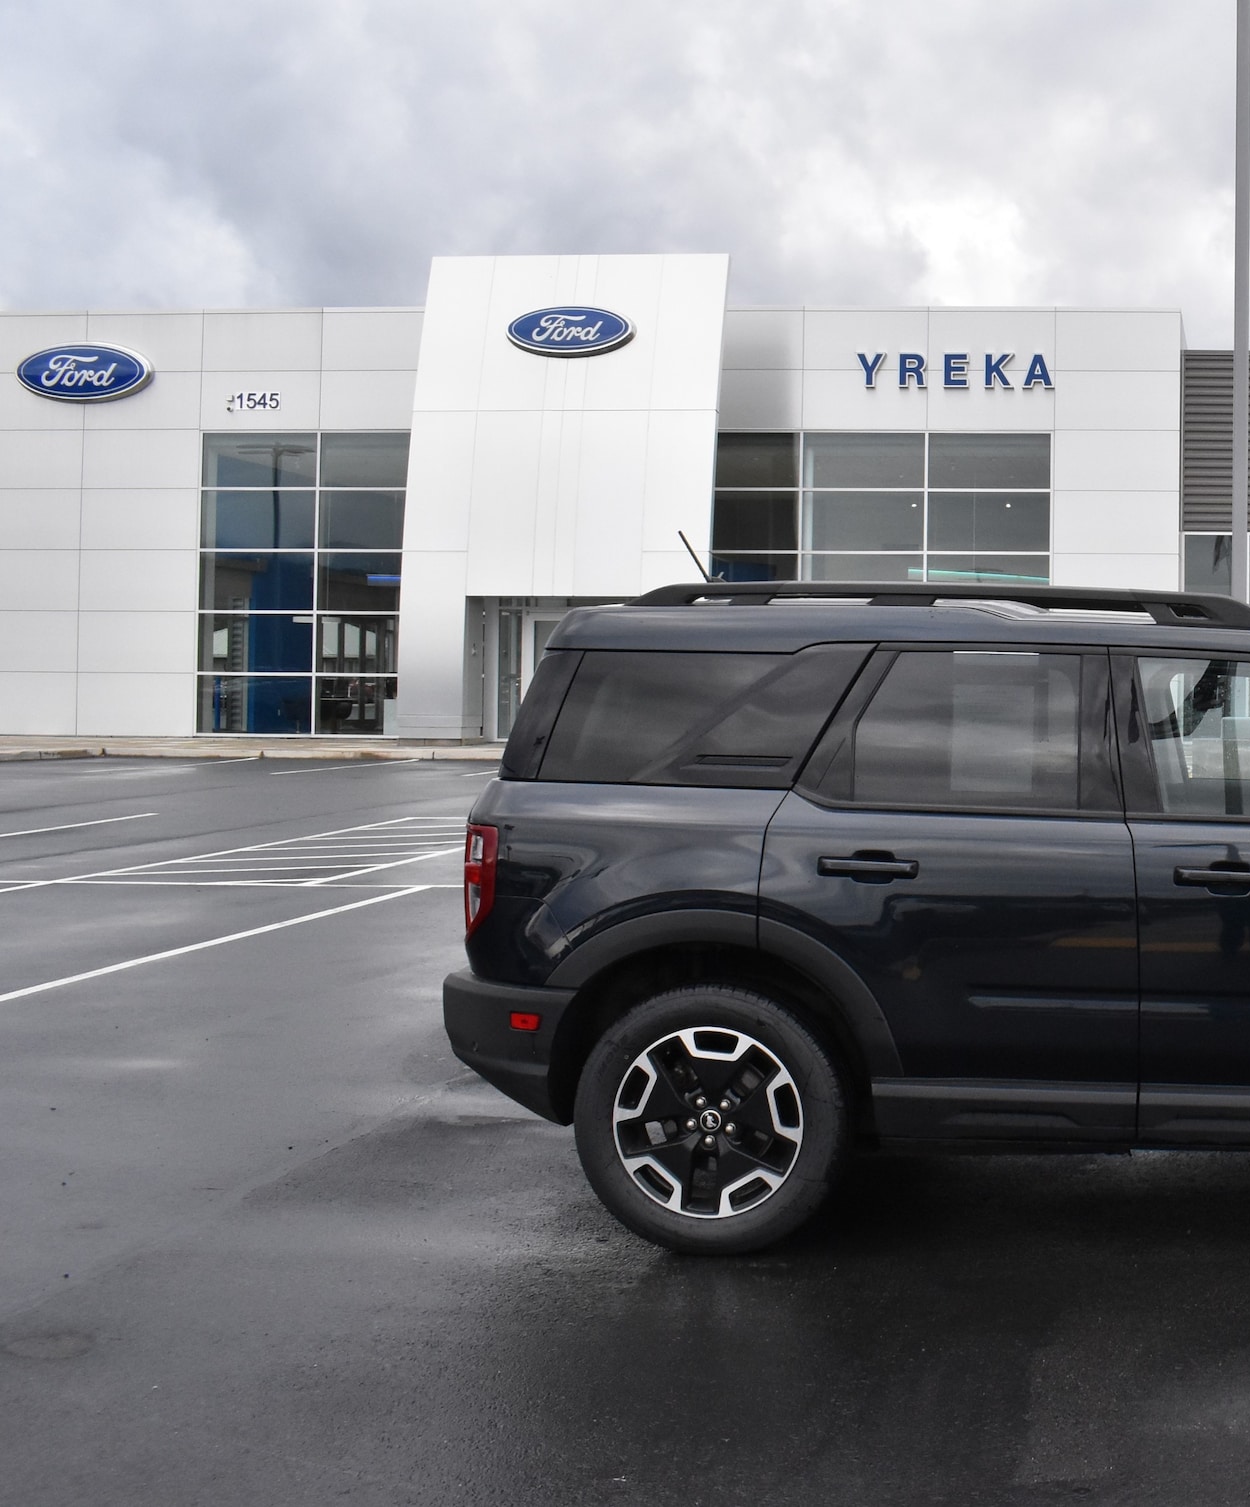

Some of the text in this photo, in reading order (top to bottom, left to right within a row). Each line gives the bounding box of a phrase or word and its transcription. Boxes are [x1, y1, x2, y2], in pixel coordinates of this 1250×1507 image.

[534, 314, 604, 341] Ford
[41, 354, 117, 387] Ford
[856, 351, 1055, 389] YREKA
[236, 392, 280, 409] 1545
